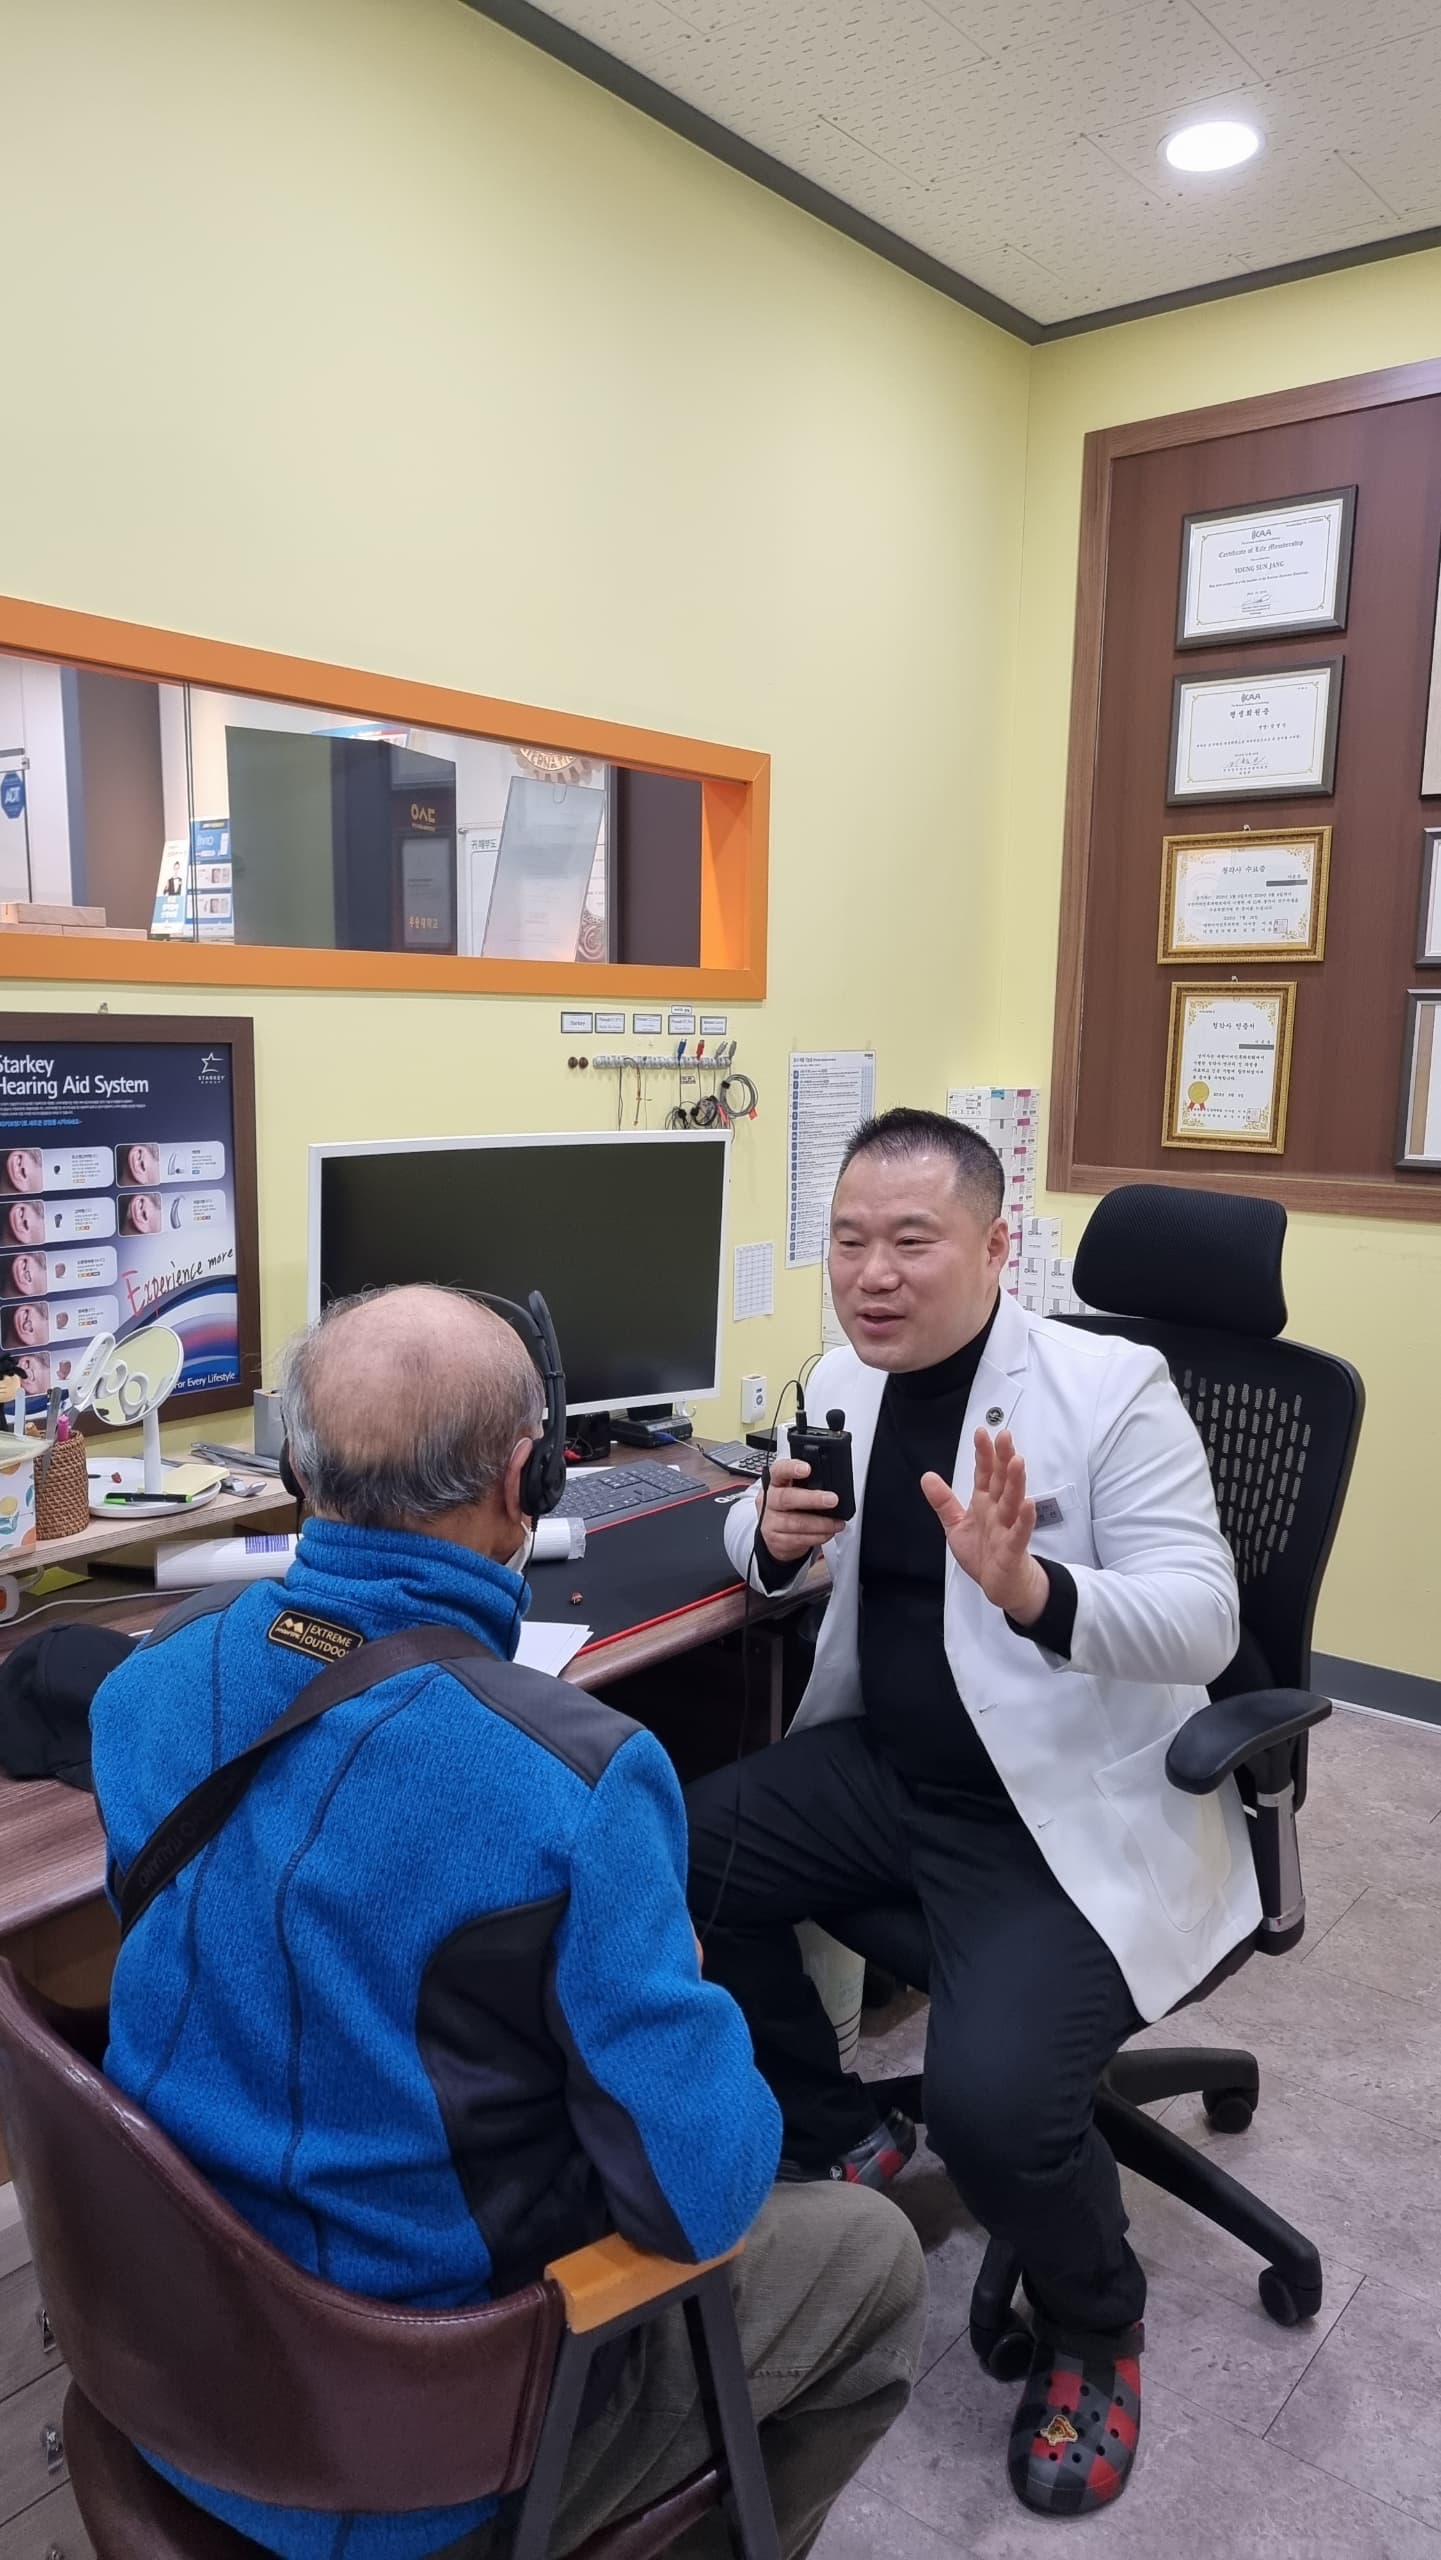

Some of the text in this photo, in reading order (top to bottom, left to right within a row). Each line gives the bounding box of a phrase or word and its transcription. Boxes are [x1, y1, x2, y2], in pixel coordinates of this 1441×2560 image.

[62, 1075, 90, 1094] Aid
[94, 1075, 149, 1098] System
[121, 1260, 203, 1317] Experience
[207, 1248, 233, 1270] more
[187, 1377, 206, 1387] Every
[207, 1371, 236, 1384] Lifestyle
[304, 1635, 349, 1658] OUTDOO
[310, 1624, 353, 1648] EXTREME
